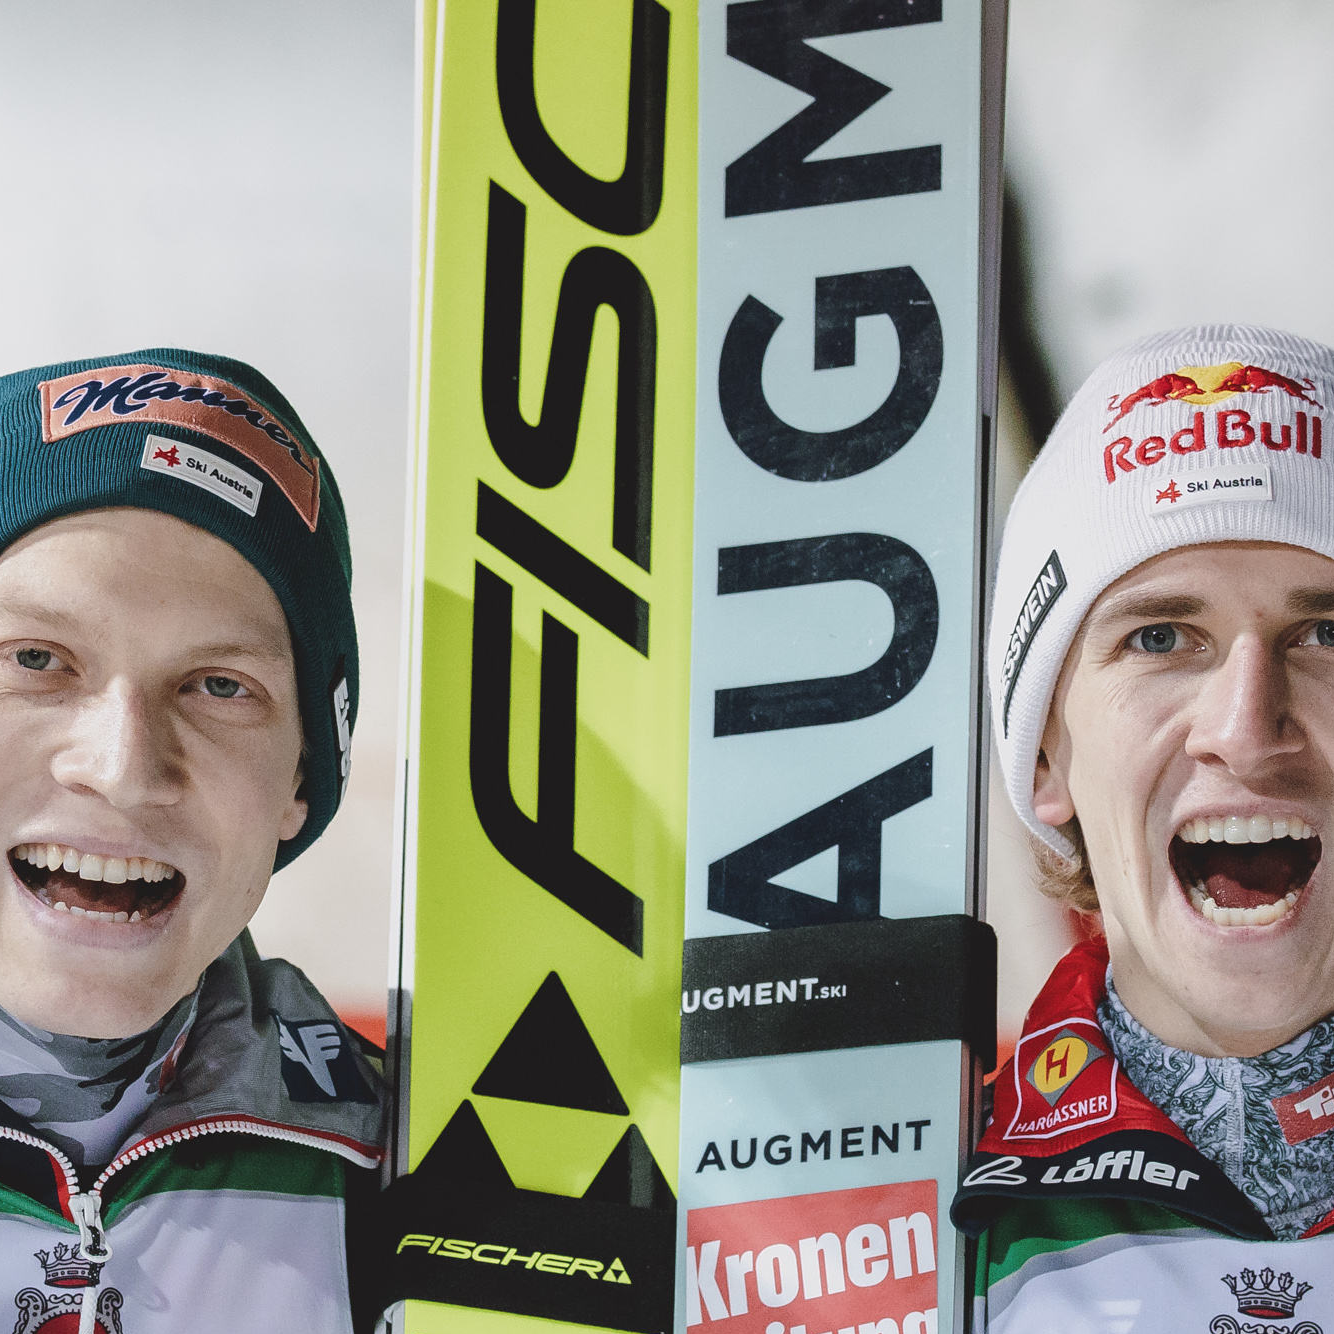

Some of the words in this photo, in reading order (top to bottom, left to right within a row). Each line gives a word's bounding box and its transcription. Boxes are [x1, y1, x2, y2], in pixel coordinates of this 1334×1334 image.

[51, 371, 314, 476] Manner
[1103, 412, 1206, 484] Red
[1217, 410, 1323, 458] Bull
[185, 456, 208, 475] Ski
[209, 465, 254, 500] Austria
[469, 0, 669, 959] FISC
[707, 0, 944, 930] AUGM
[1186, 480, 1209, 494] Ski
[1212, 476, 1264, 491] Austria
[1000, 564, 1058, 697] ESSWEIN
[680, 978, 847, 1016] UGMENT.SKI
[695, 1119, 932, 1173] AUGMENT
[1015, 1095, 1109, 1135] HARGASSNER
[396, 1234, 604, 1279] FISCHER
[686, 1211, 935, 1326] Kronen
